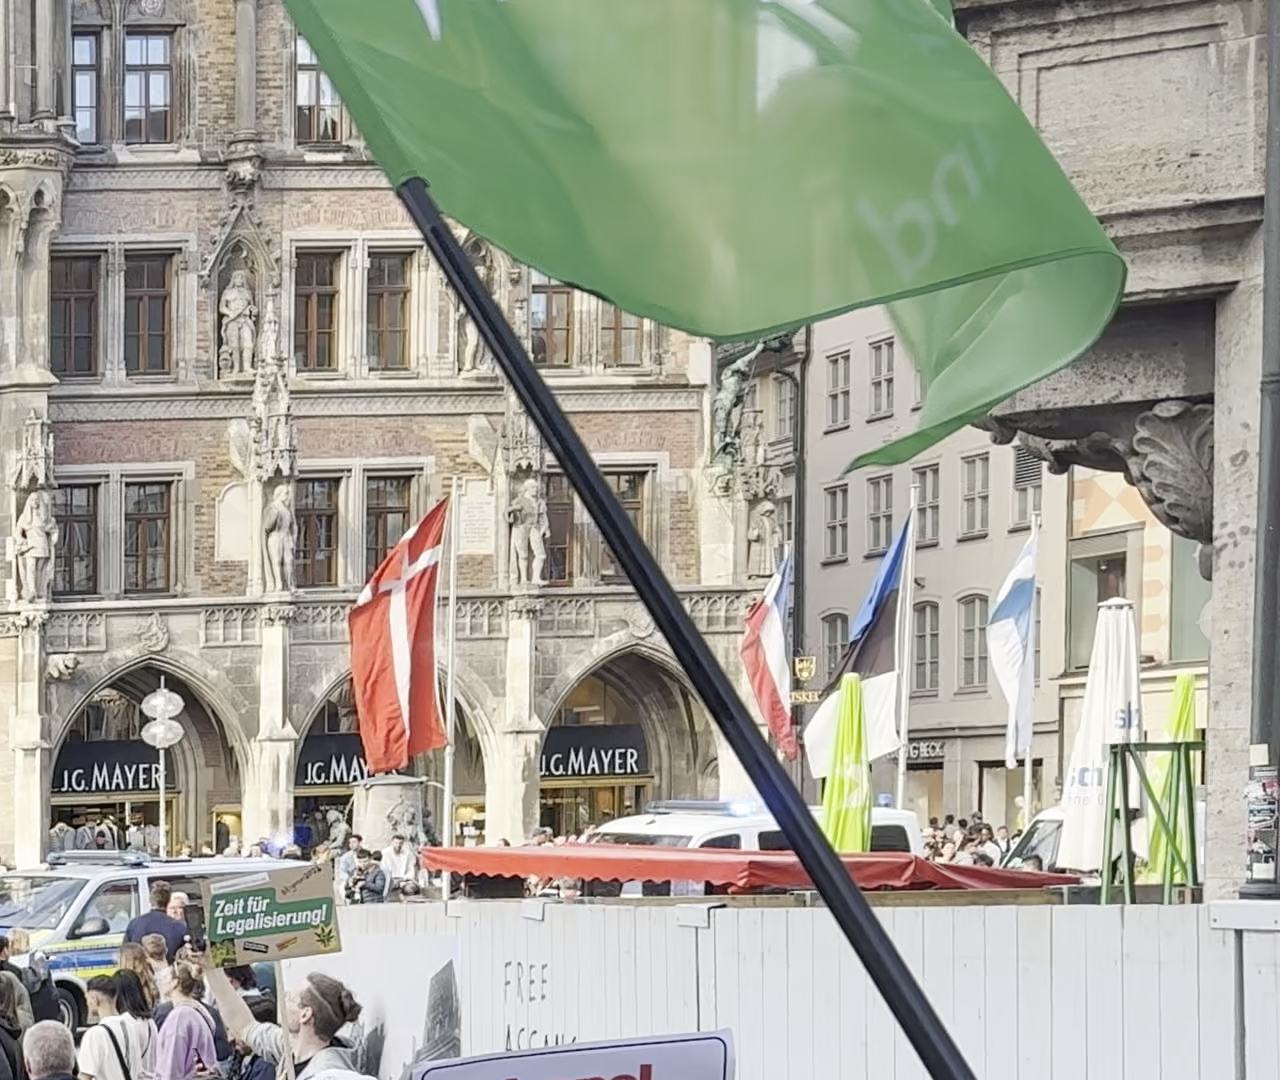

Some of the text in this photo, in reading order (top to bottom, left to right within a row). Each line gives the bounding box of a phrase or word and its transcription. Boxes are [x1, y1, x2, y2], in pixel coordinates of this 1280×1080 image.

[567, 746, 639, 775] MAYER
[91, 761, 162, 791] MAYER
[213, 896, 270, 918] Zeit für
[216, 904, 327, 936] Legalisierung!
[504, 960, 548, 1004] FREE
